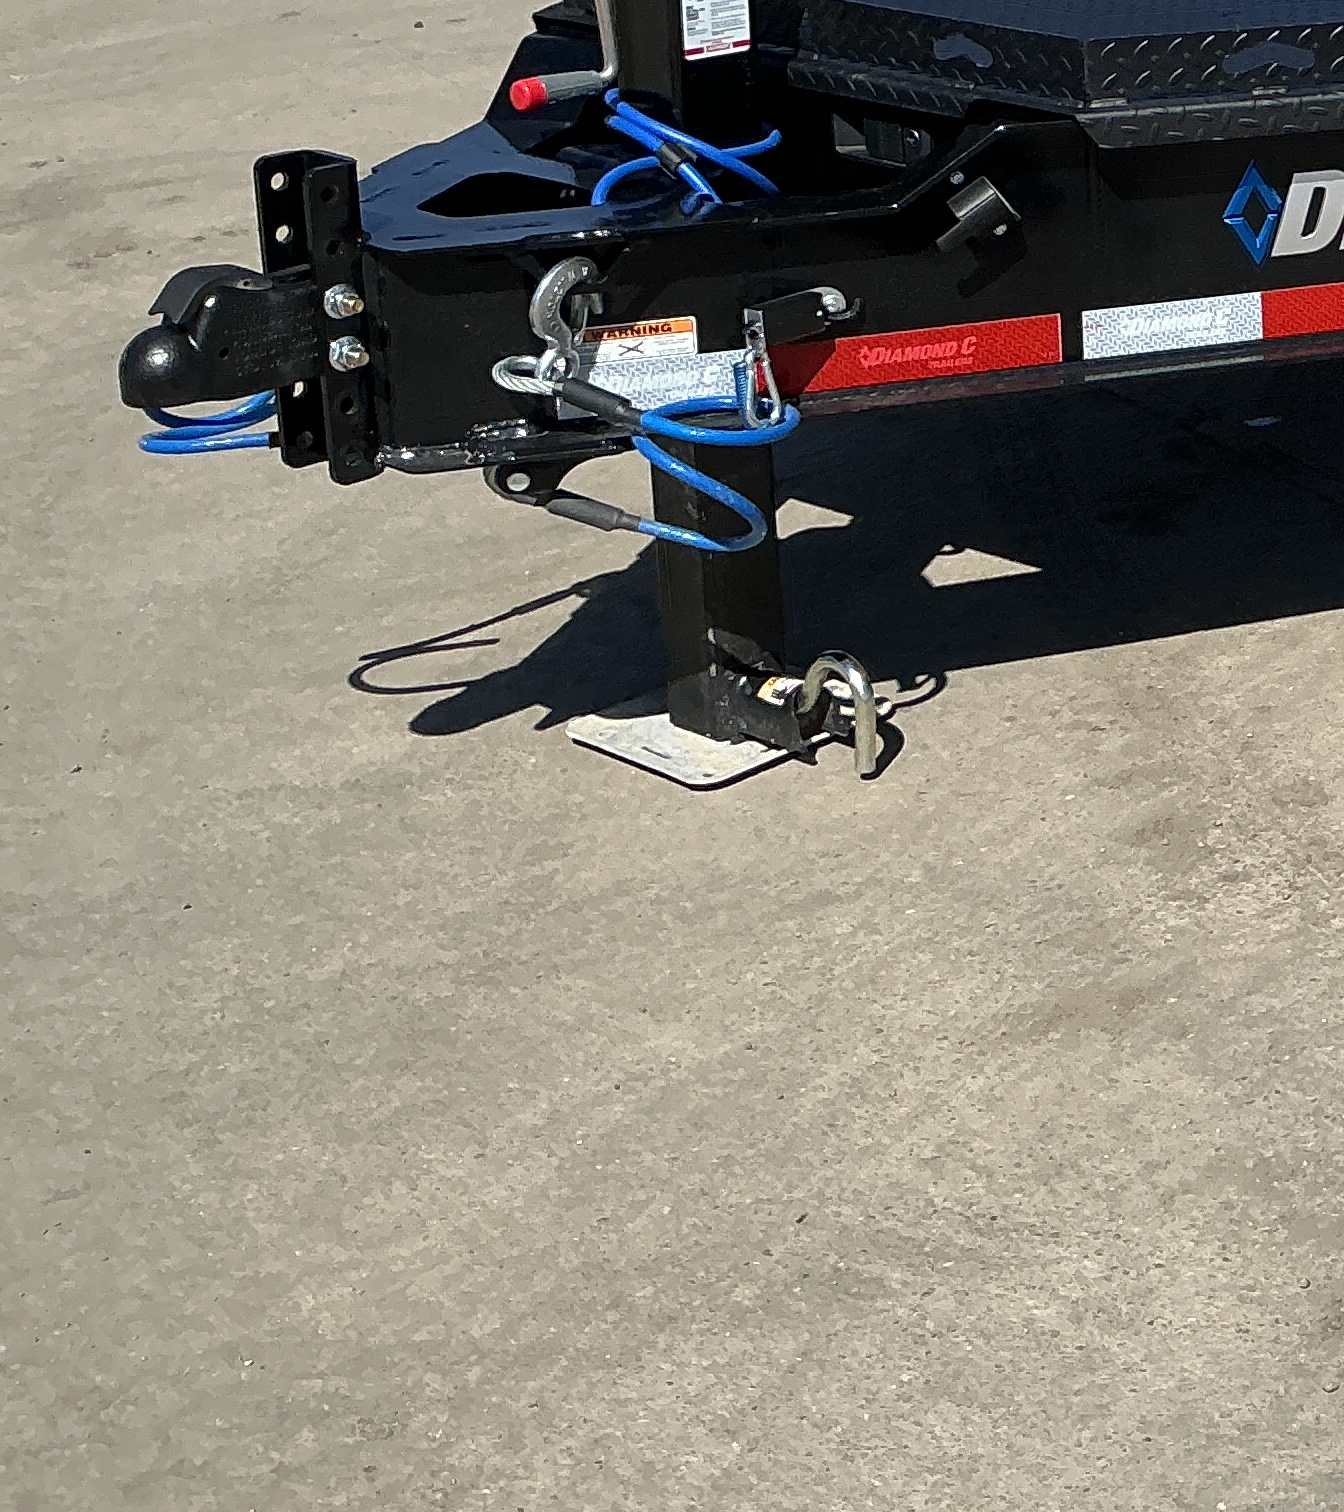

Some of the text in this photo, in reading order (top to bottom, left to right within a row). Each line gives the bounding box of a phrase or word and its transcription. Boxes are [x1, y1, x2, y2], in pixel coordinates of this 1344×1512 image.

[593, 322, 672, 340] WARNING
[869, 335, 977, 367] DIAMOND C
